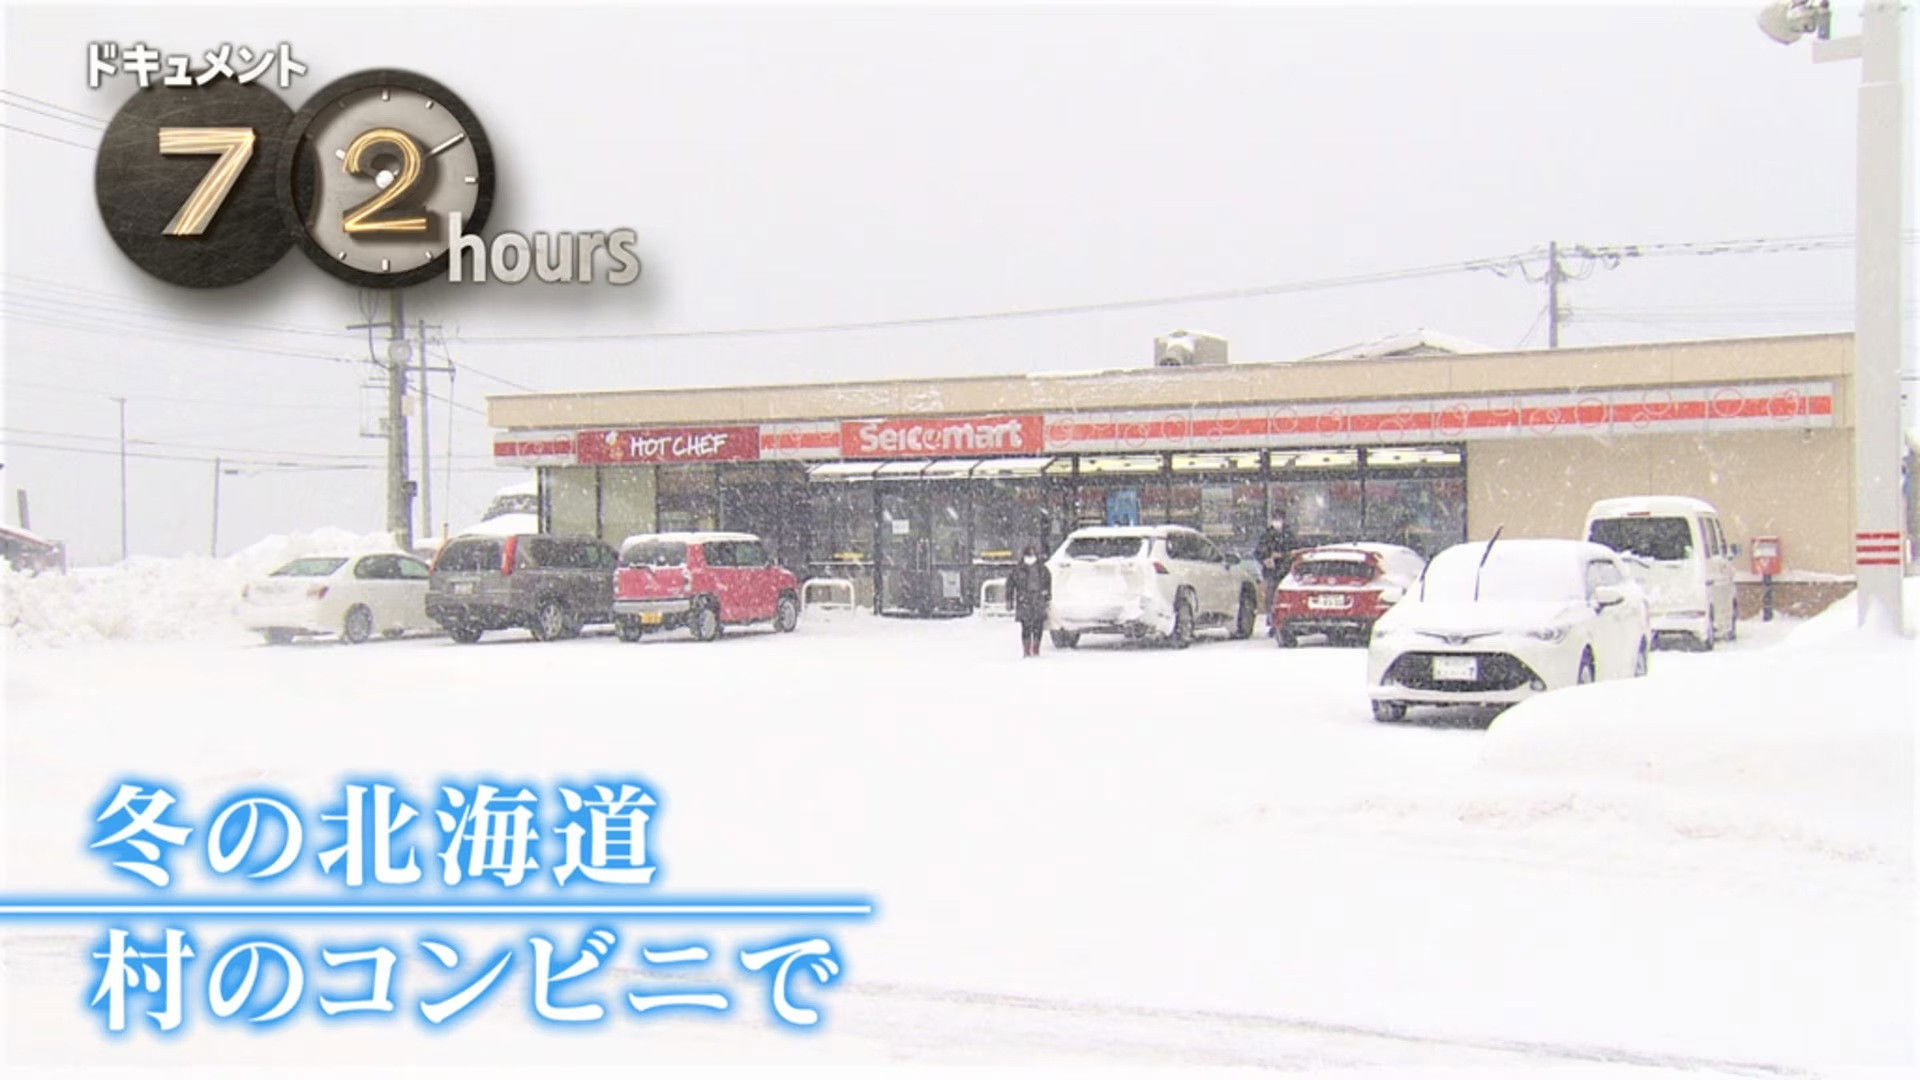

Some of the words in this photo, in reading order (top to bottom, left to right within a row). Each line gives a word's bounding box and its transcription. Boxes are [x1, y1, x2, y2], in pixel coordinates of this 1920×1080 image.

[629, 435, 672, 458] HOT
[671, 432, 729, 457] CHEF
[858, 418, 1024, 452] Seicomart
